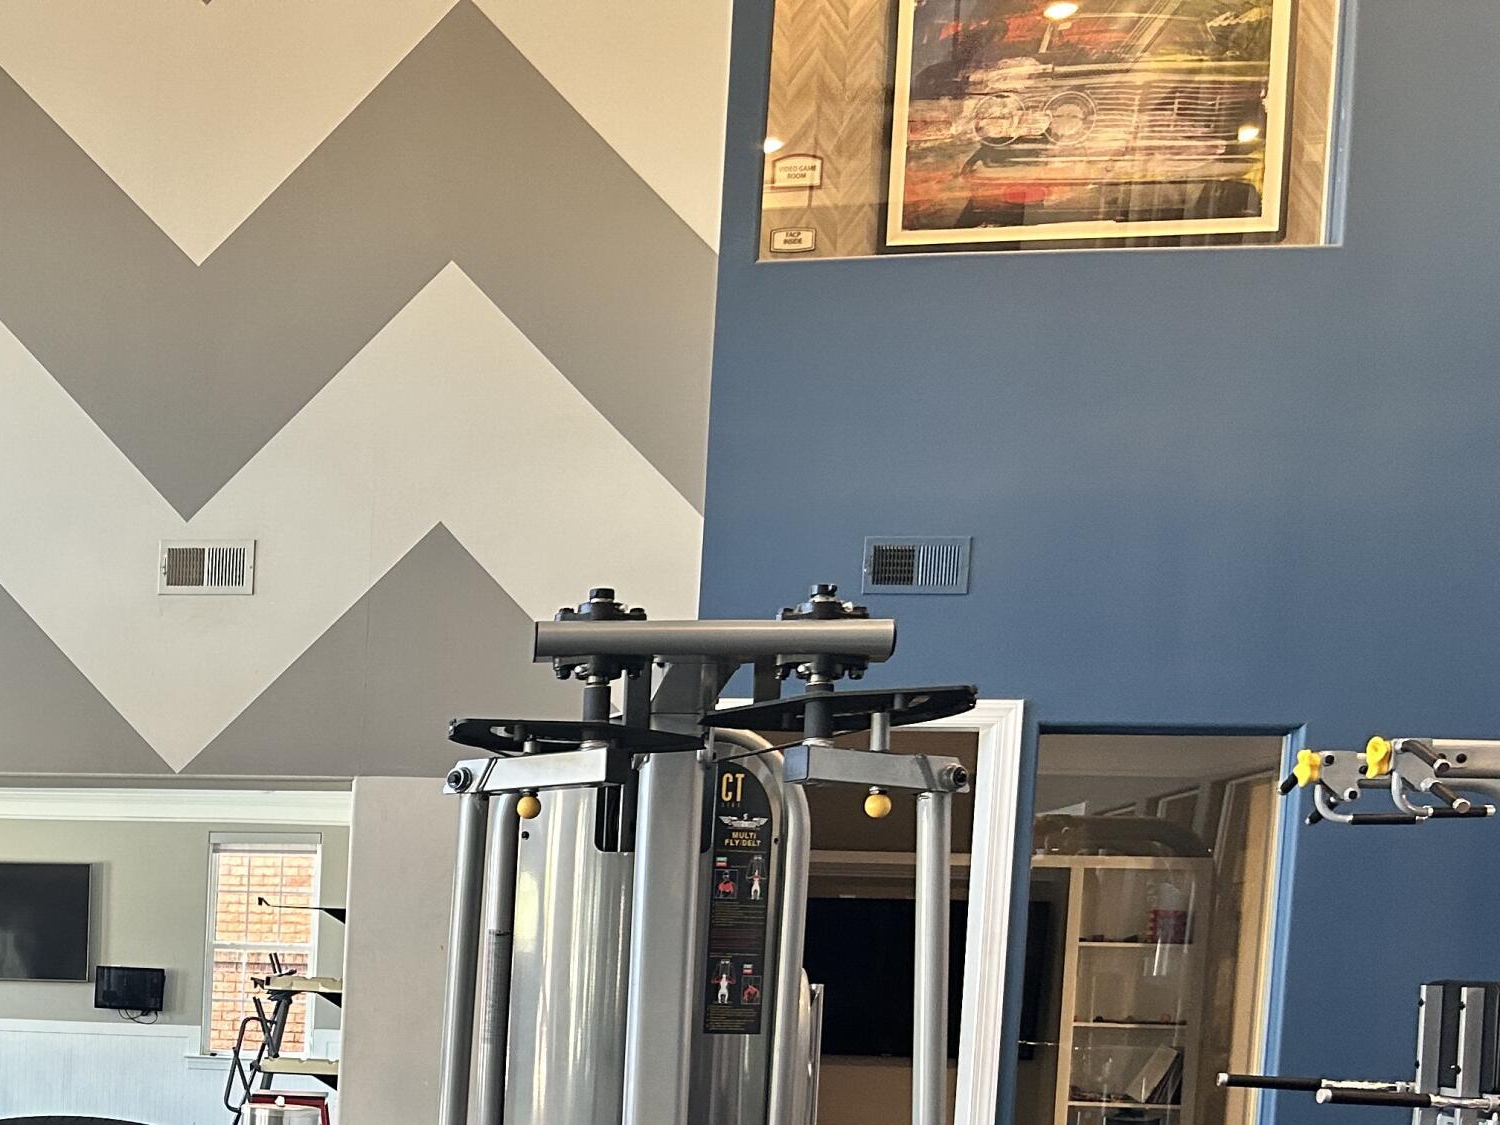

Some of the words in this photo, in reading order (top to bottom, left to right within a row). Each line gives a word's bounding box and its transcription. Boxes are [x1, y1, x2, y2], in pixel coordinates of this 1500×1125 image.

[799, 164, 817, 172] GAME
[721, 772, 746, 802] CT
[731, 831, 757, 839] MULTI
